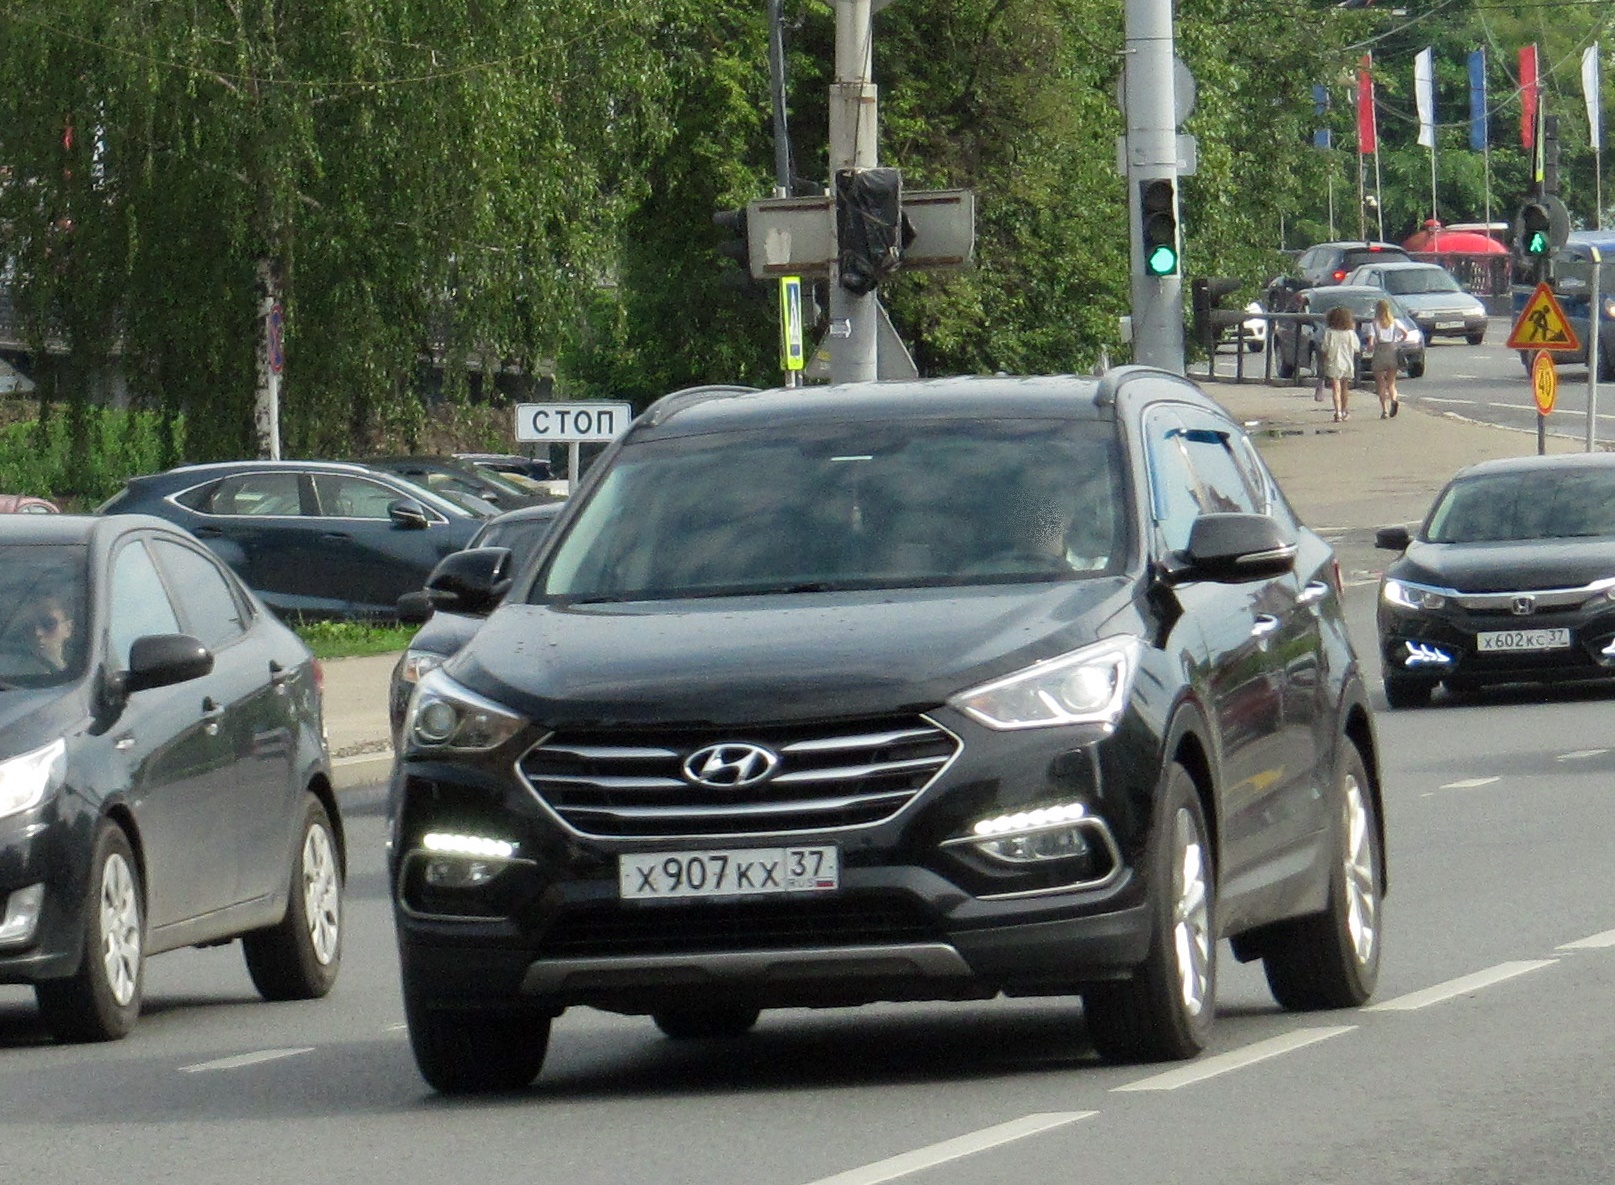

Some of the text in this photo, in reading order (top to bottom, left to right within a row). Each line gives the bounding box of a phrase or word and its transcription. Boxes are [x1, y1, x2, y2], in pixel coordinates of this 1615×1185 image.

[1538, 370, 1552, 396] 40
[532, 410, 614, 434] СТОП
[790, 851, 824, 877] 37
